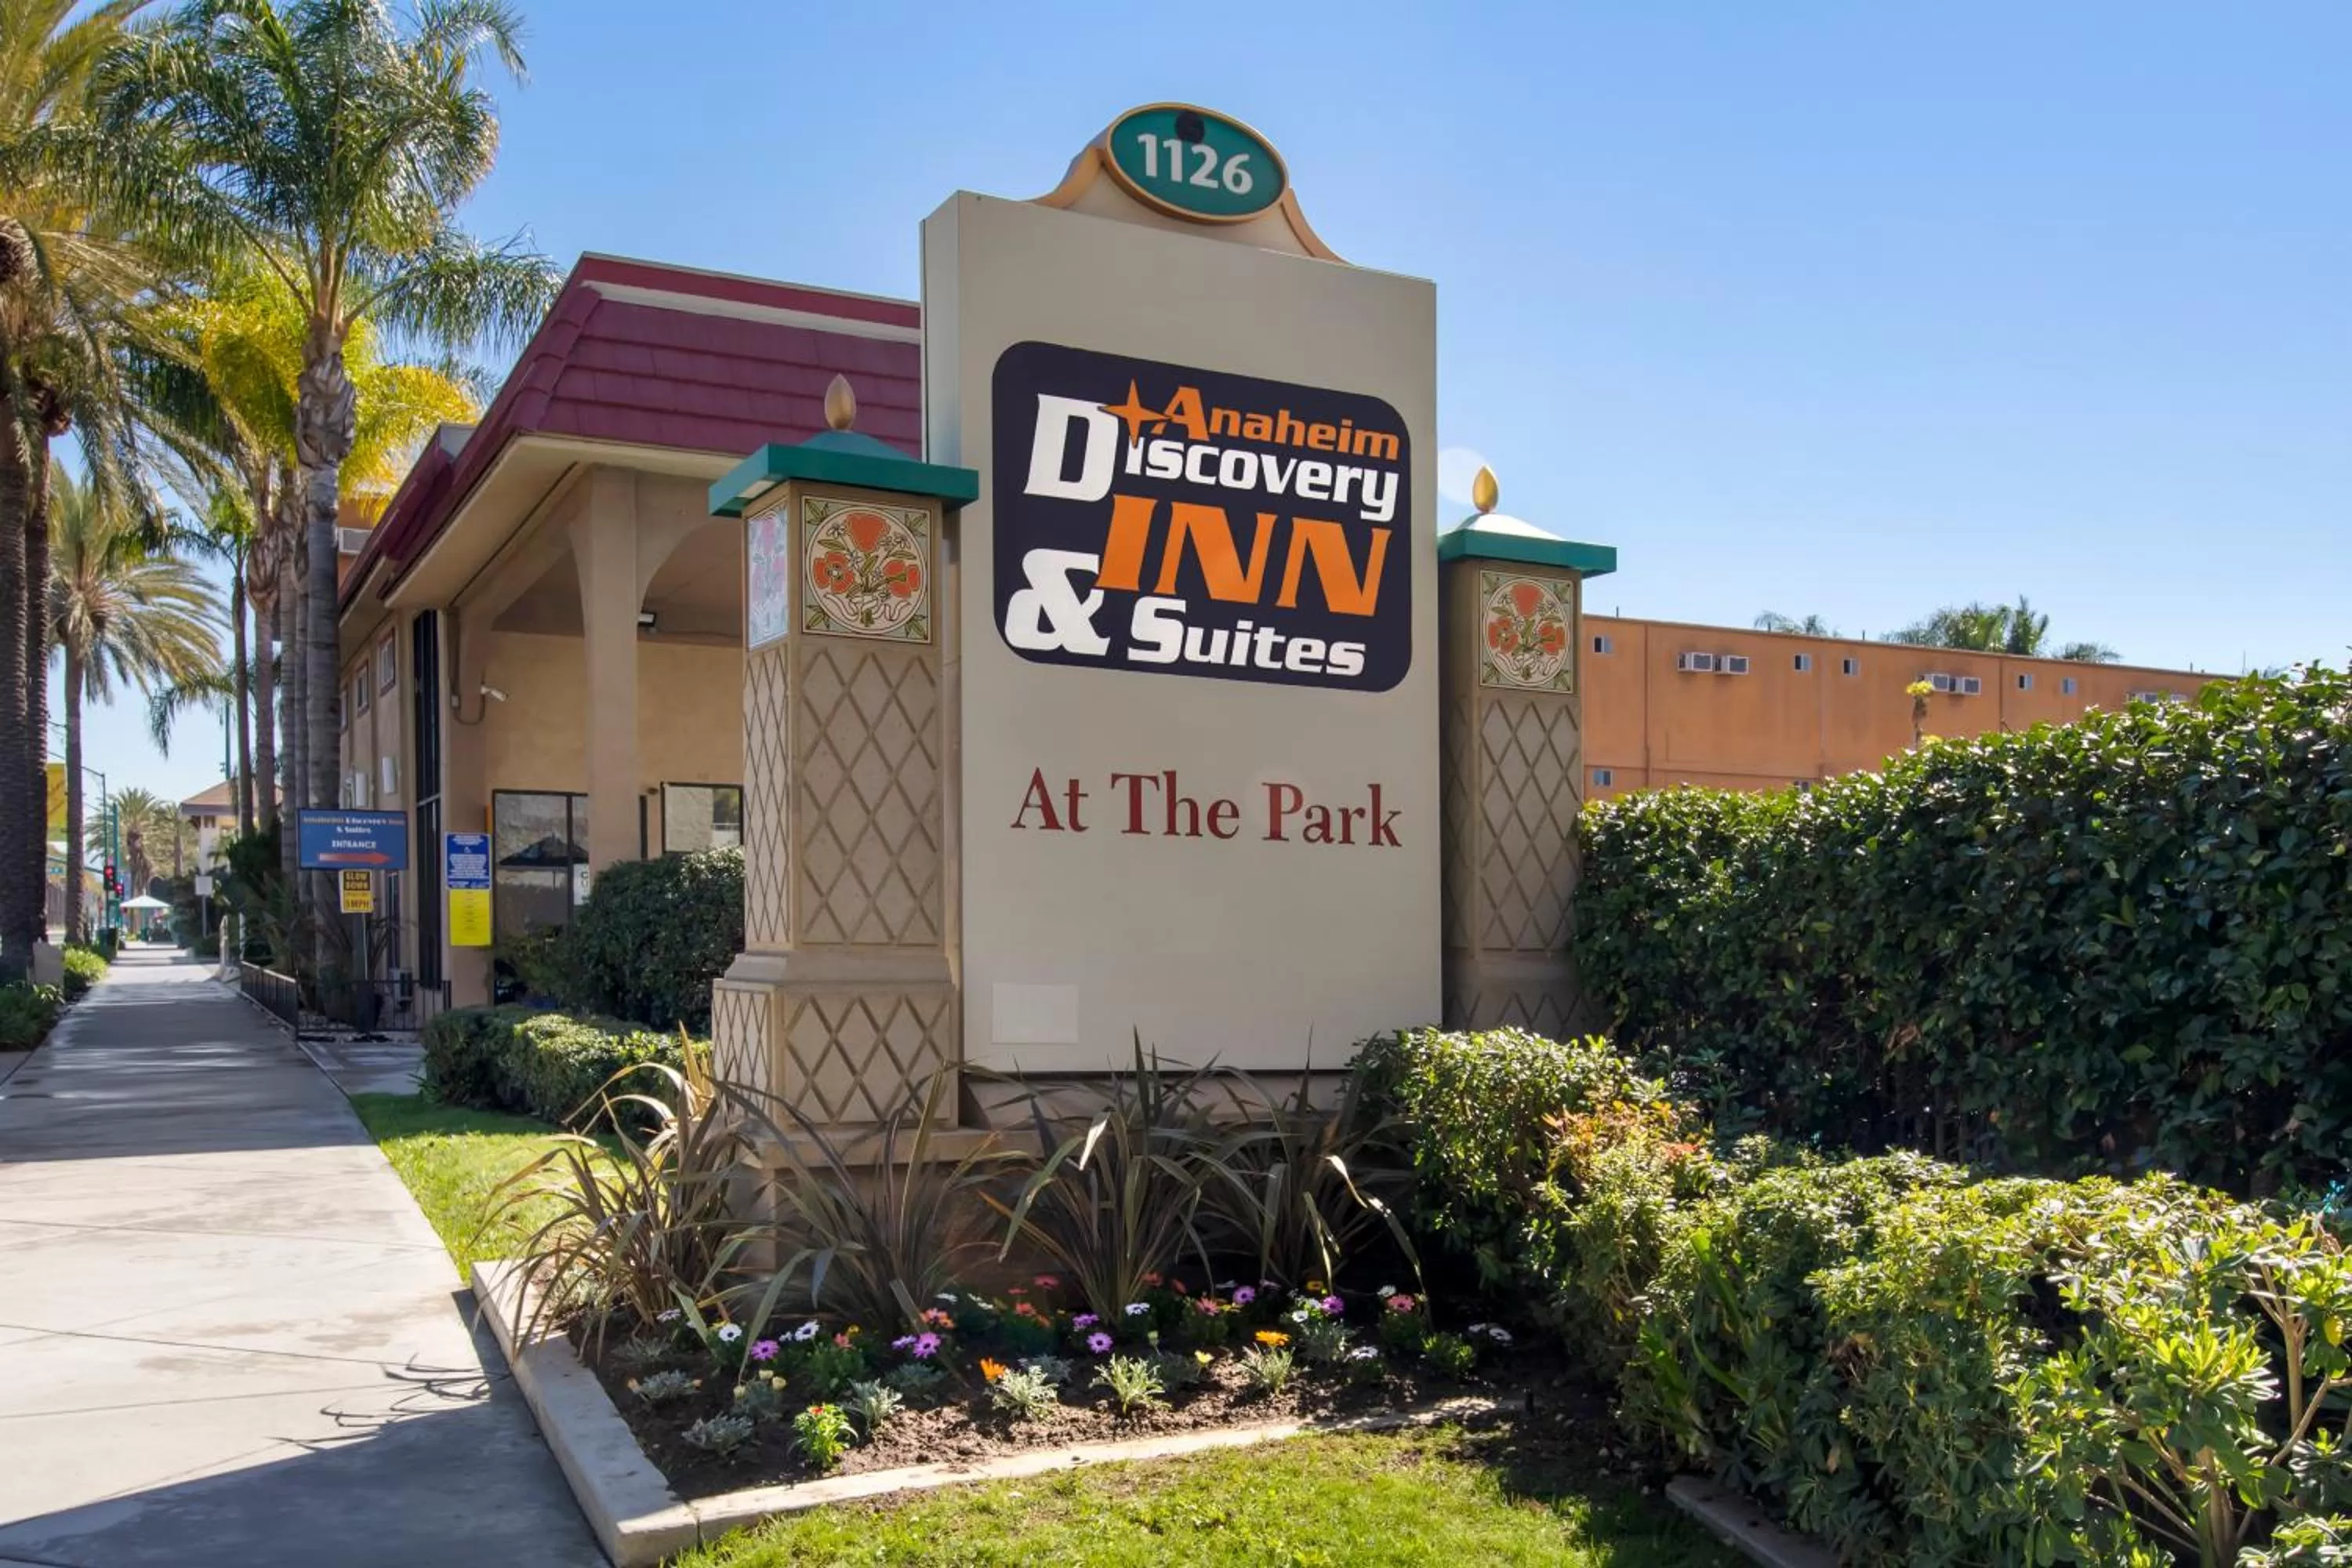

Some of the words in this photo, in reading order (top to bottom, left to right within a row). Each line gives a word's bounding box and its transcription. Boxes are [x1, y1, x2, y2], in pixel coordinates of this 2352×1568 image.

[1137, 132, 1254, 195] 1126
[1023, 393, 1399, 522] Discovery
[1149, 386, 1399, 461] Anaheim
[1092, 493, 1392, 616] INN
[1004, 548, 1111, 656] &
[1127, 595, 1367, 677] Suites
[331, 840, 376, 848] ENTRANCE
[1011, 766, 1090, 833] At
[1111, 770, 1241, 840] The
[1261, 781, 1403, 848] Park
